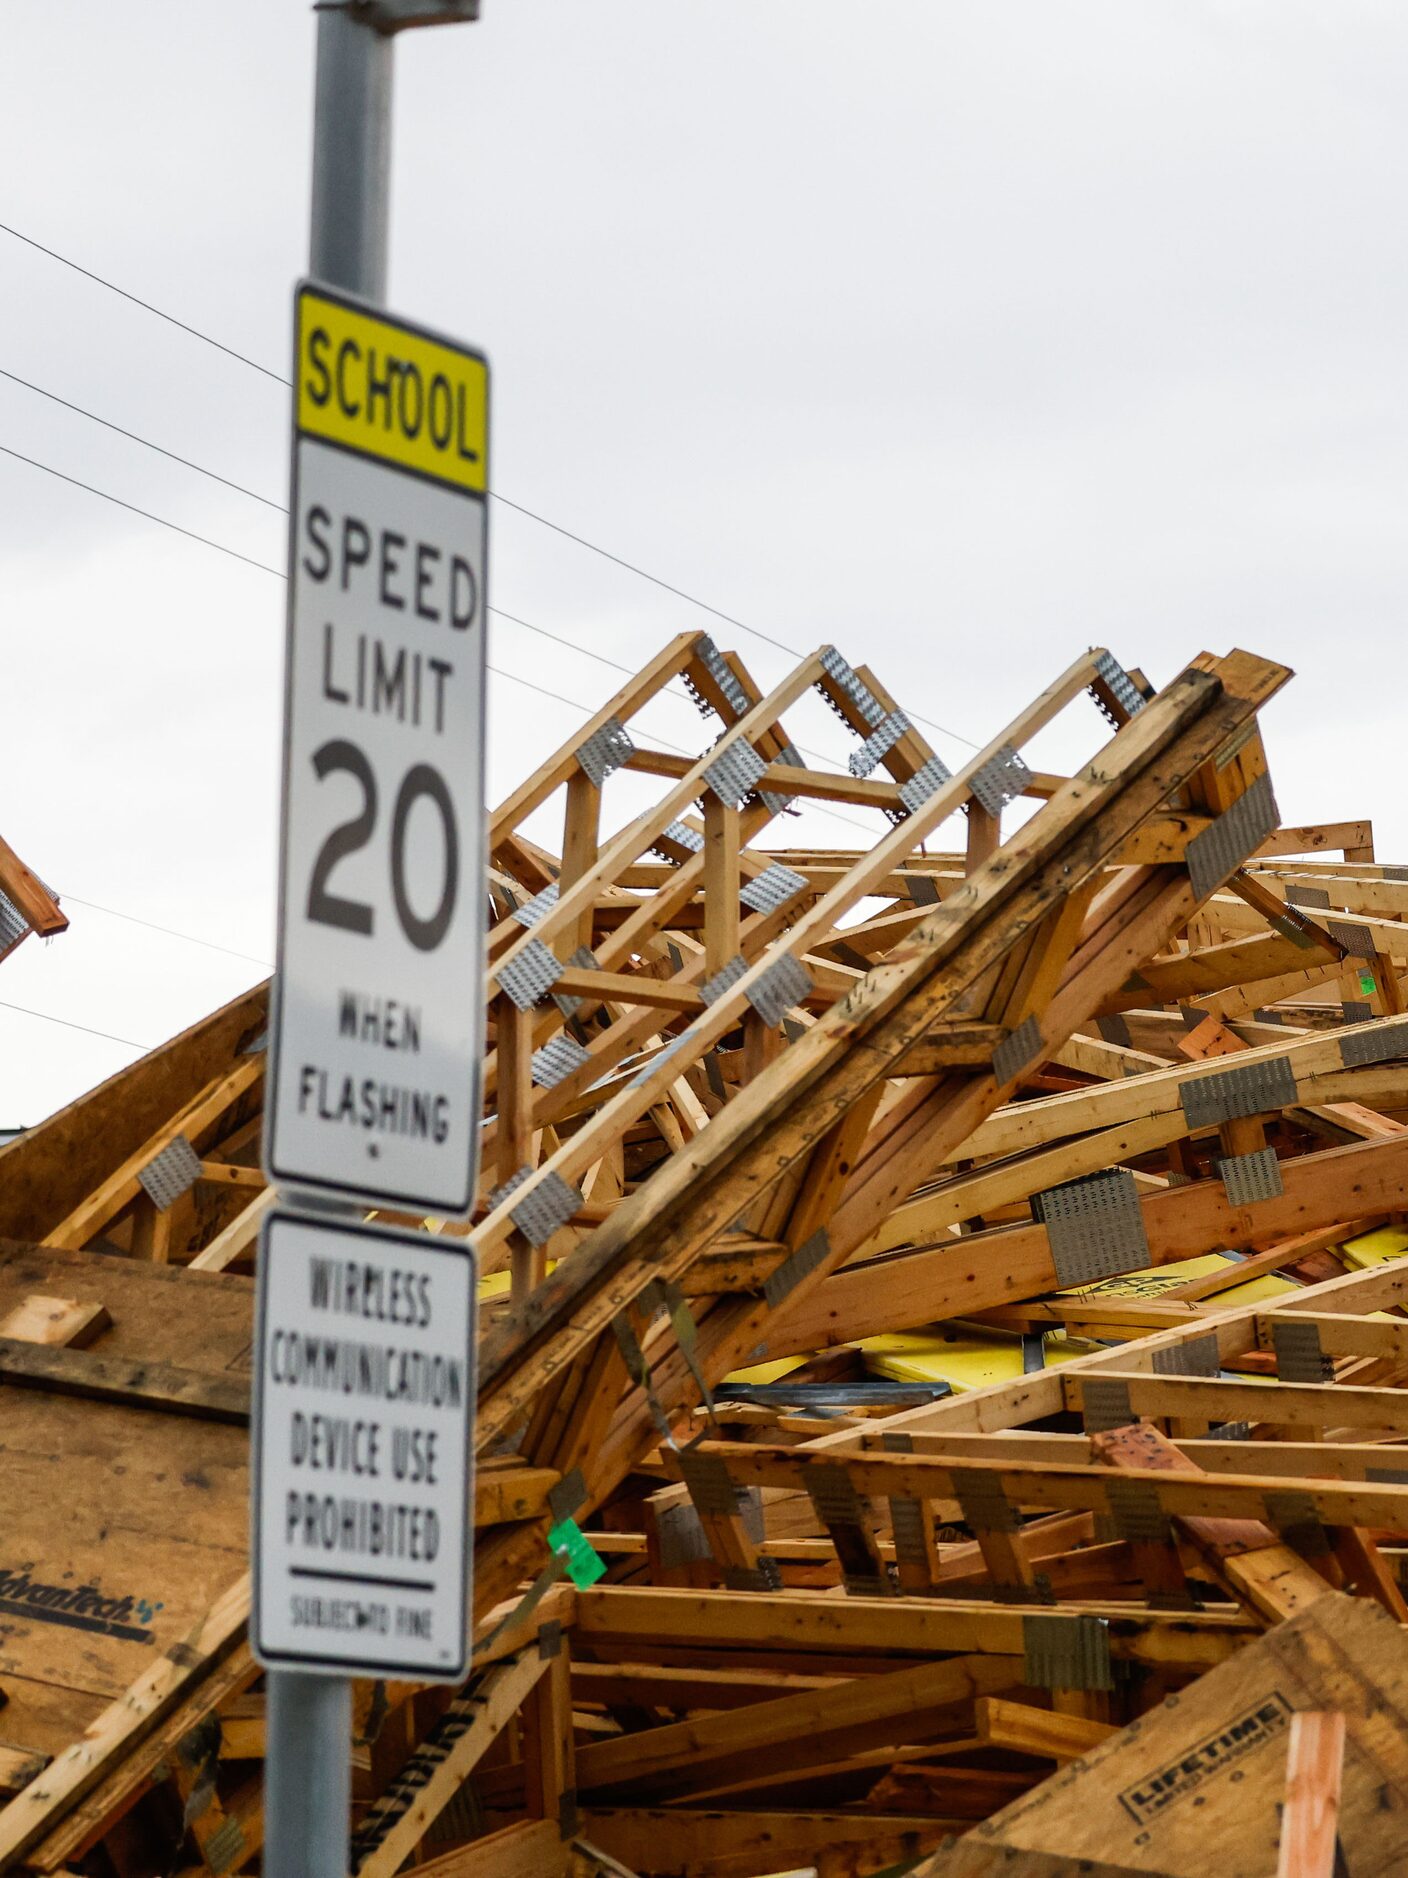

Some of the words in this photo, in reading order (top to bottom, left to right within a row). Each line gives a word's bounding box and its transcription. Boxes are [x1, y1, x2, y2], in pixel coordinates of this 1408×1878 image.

[305, 326, 479, 464] SCHOOL
[303, 504, 478, 631] SPEED
[323, 622, 454, 735] LIMIT
[306, 738, 460, 952] 20
[338, 988, 422, 1055] WHEN
[299, 1065, 450, 1145] FLASHING
[310, 1255, 432, 1329] WIRELESS
[270, 1329, 461, 1409] COMMUNICATION
[290, 1411, 381, 1477] DEVICE
[391, 1424, 439, 1486] USE
[285, 1489, 440, 1564] PROHIBITED
[1130, 1702, 1281, 1806] LIFETIME
